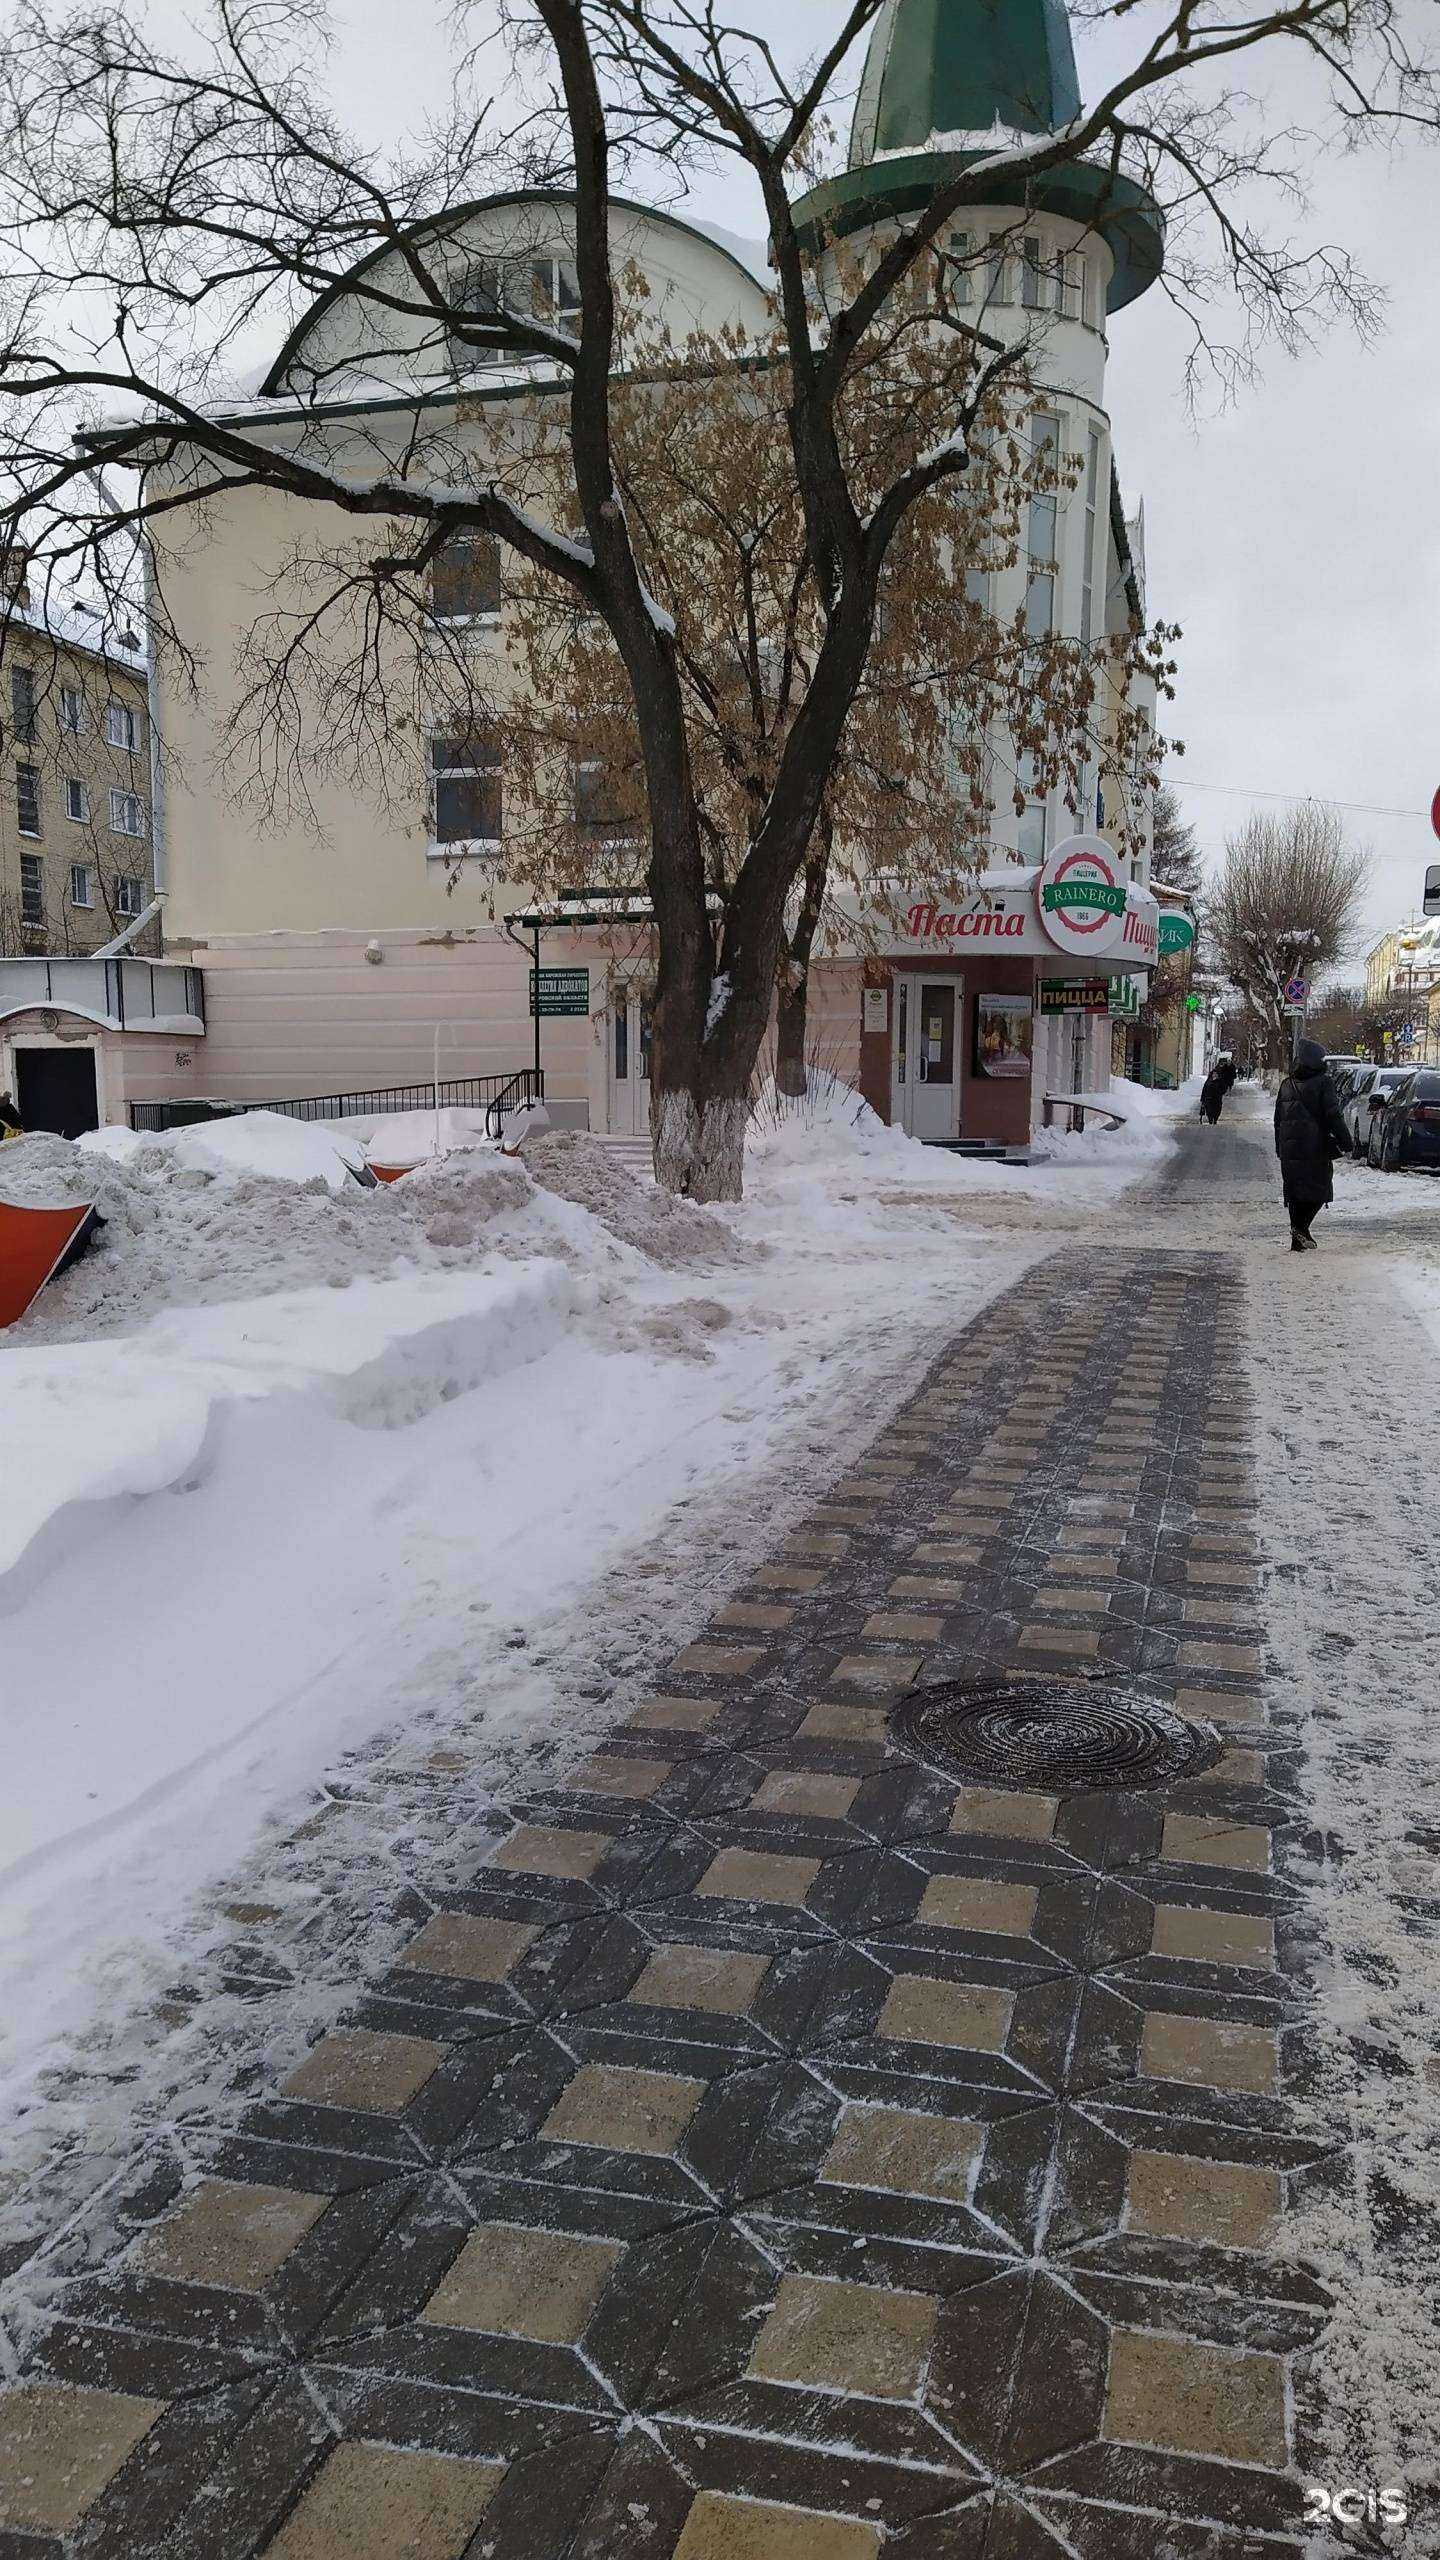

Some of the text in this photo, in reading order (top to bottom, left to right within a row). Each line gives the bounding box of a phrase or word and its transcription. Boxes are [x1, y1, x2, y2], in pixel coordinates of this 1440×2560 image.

[1054, 887, 1117, 906] RAINERO
[907, 902, 1026, 937] Паста
[1123, 911, 1157, 954] Пицц
[1042, 990, 1107, 1006] ПИЦЦА
